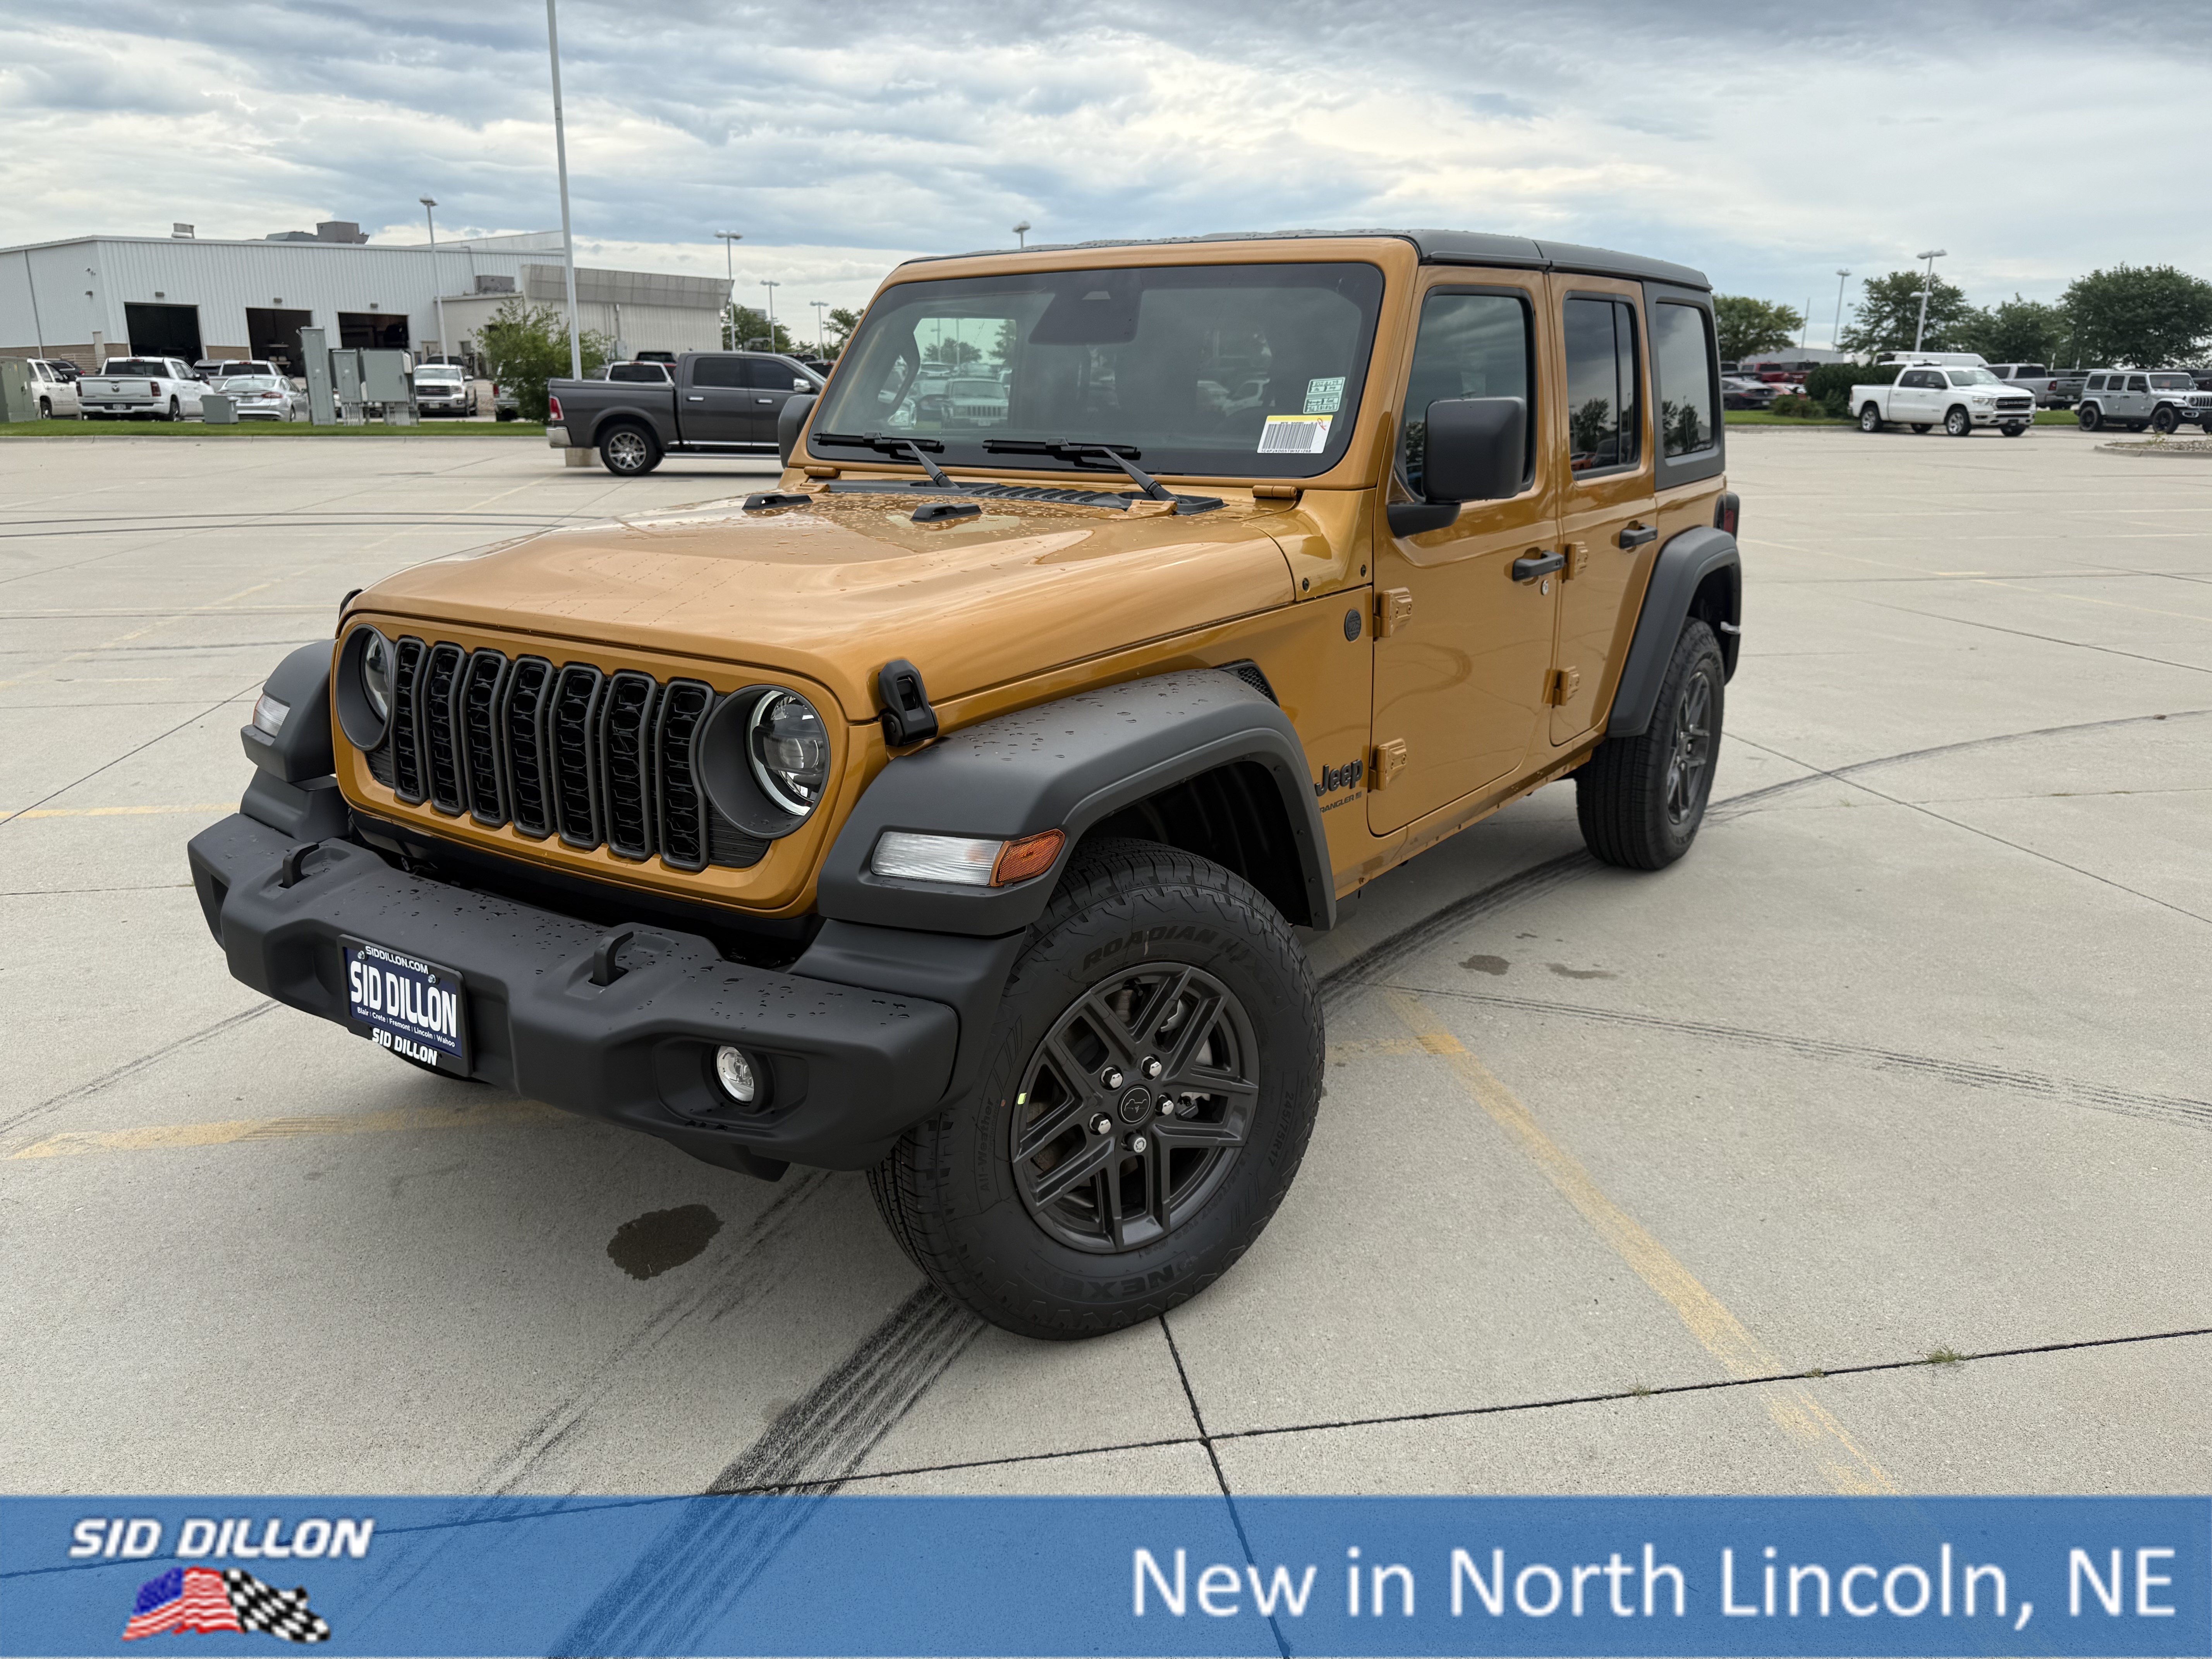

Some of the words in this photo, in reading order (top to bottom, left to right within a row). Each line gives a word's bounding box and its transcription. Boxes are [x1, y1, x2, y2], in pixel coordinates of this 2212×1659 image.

[1314, 759, 1363, 797] Jeep
[1319, 794, 1354, 813] RANGLER
[365, 946, 429, 974] SIDDILLON.COM
[1083, 926, 1219, 971] ROADIAN
[350, 961, 381, 1010] SID
[386, 972, 456, 1038] DILLON
[357, 1007, 369, 1016] Blair
[373, 1012, 386, 1022] Crete
[389, 1019, 410, 1031] Fremont
[414, 1028, 433, 1039] Lincoln
[436, 1035, 455, 1047] Wahoo
[372, 1027, 392, 1048] SID
[394, 1036, 438, 1066] DILLON
[978, 1097, 993, 1192] All-Weather
[1267, 1092, 1294, 1168] 245/75R17
